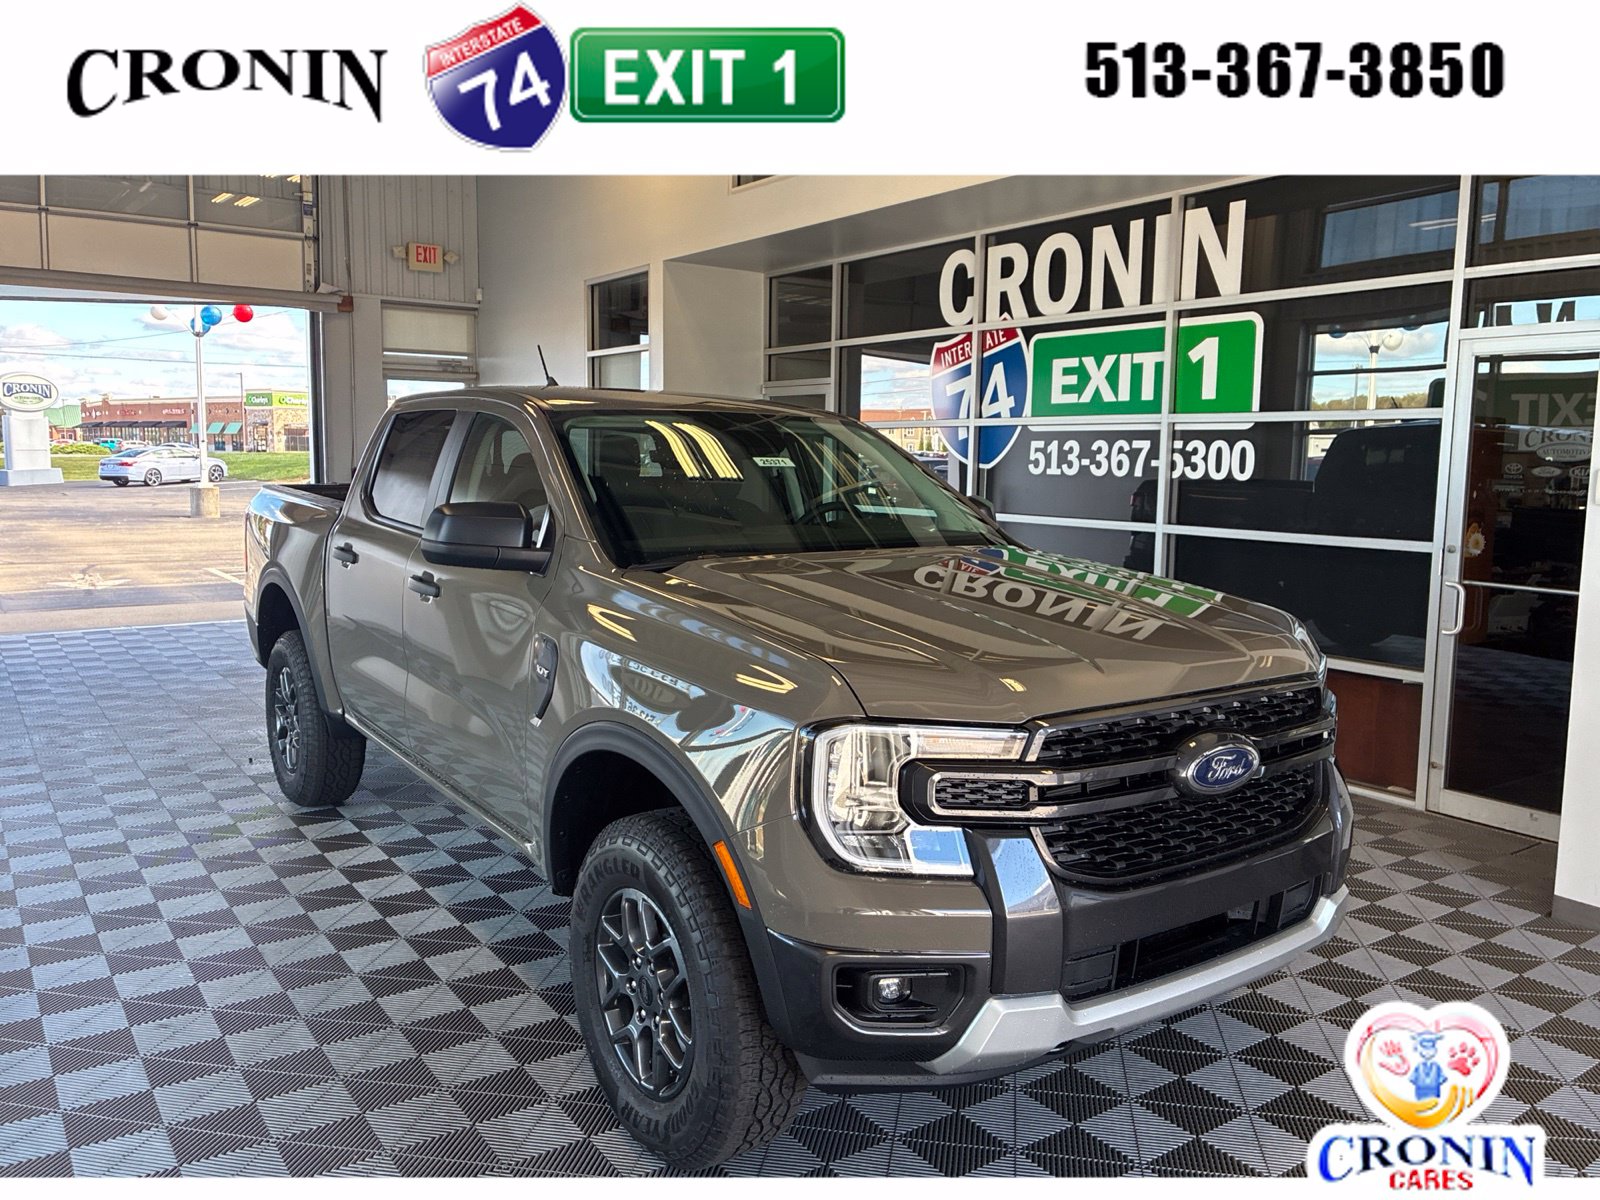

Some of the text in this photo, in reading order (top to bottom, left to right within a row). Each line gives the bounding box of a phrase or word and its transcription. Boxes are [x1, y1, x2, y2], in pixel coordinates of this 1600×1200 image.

[416, 245, 438, 265] EXIT
[939, 200, 1246, 327] CRONIN
[941, 330, 1007, 369] INTERATE
[3, 382, 50, 398] CRONIN
[1051, 336, 1220, 405] EXIT 1
[946, 361, 1015, 441] 74
[1207, 754, 1246, 783] Ford
